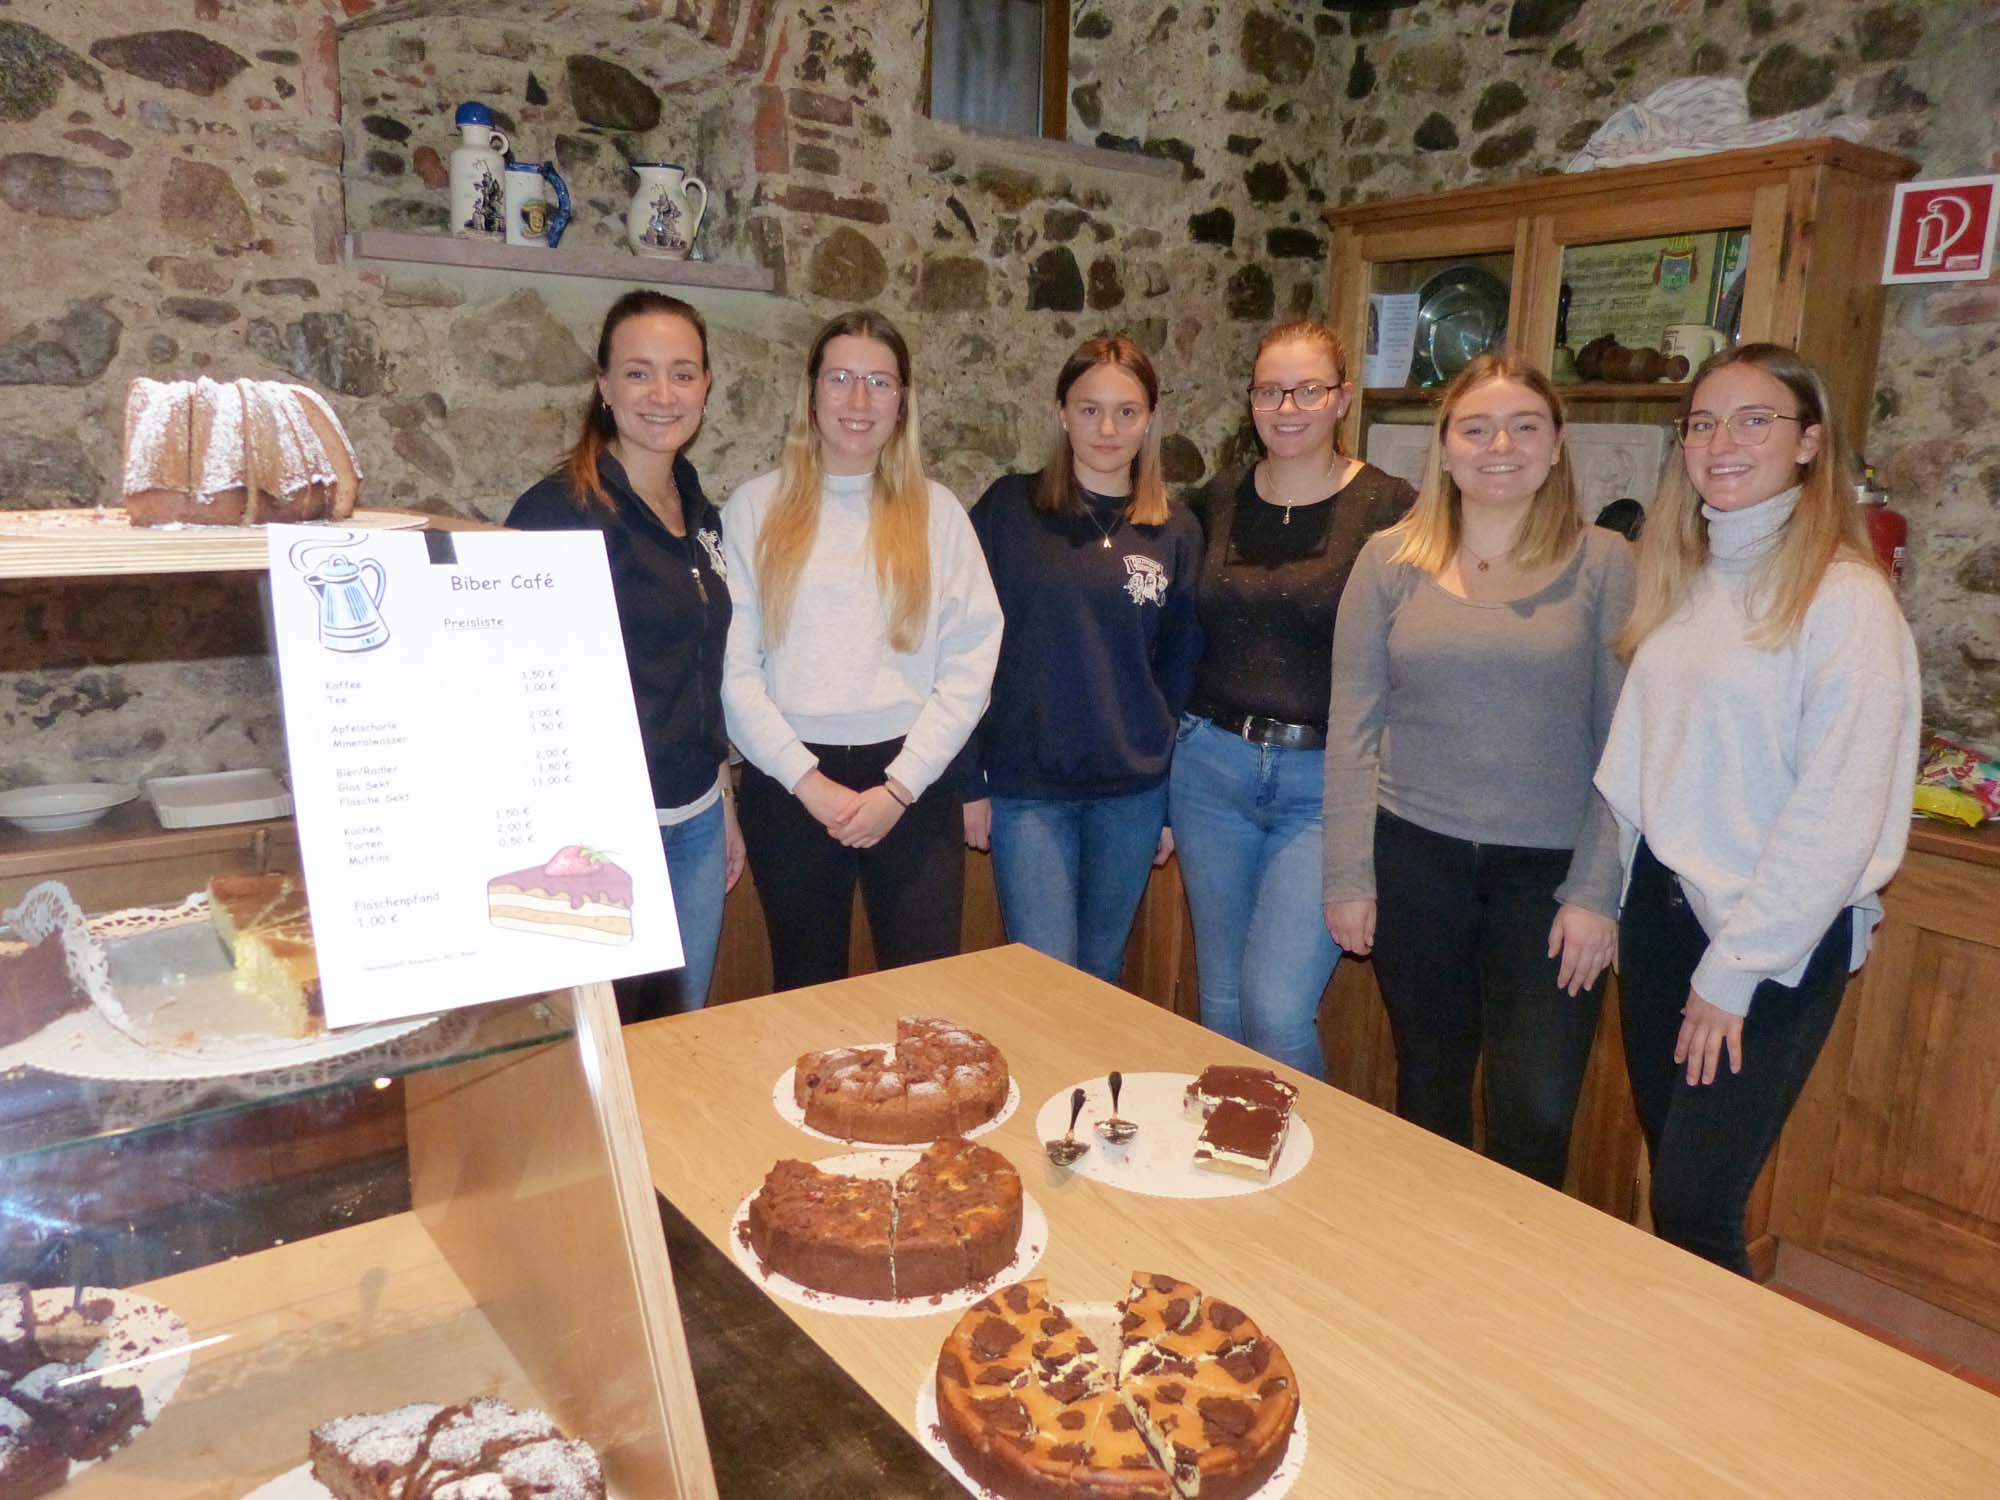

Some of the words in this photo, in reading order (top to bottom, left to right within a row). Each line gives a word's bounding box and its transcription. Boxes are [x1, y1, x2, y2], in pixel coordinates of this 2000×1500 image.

[451, 575, 502, 591] Biber
[511, 572, 555, 590] Café
[443, 616, 504, 630] Preisliste
[327, 695, 346, 704] Tee
[331, 722, 397, 737] Apfelschorle
[333, 736, 408, 749] Mineralwasser
[336, 765, 398, 778] Bier/Radler
[564, 774, 573, 784] €
[338, 783, 361, 793] Glas
[365, 780, 390, 791] Sekt
[339, 797, 380, 809] Flasche
[385, 793, 409, 803] Sekt
[523, 807, 530, 816] €
[525, 820, 532, 830] €
[344, 826, 383, 837] Kuchen
[527, 833, 535, 844] €
[345, 840, 383, 851] Torten
[349, 854, 390, 866] Muffins
[354, 892, 440, 911] Flaschenpfand
[390, 913, 399, 924] €
